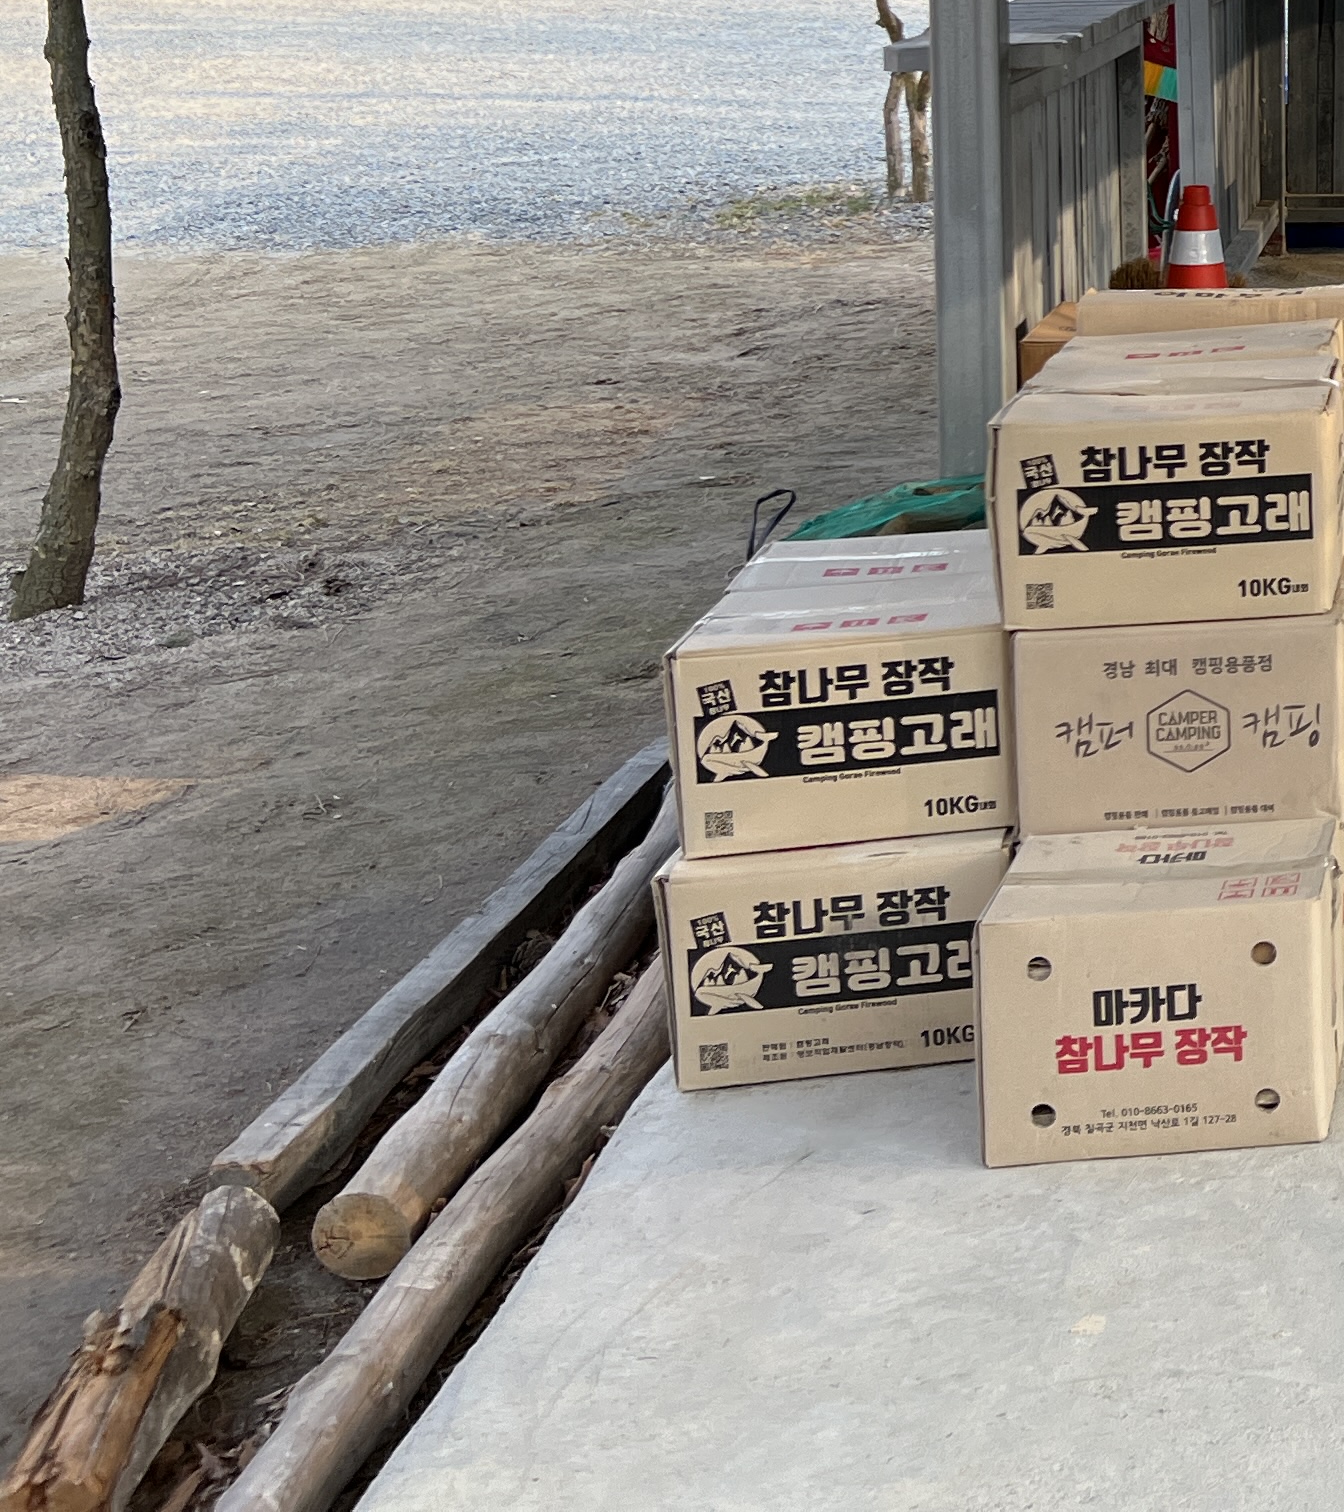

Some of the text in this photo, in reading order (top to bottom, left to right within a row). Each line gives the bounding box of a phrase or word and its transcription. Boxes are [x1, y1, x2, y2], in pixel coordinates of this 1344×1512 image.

[1080, 438, 1271, 483] 참나무 장작
[1115, 489, 1311, 542] 캠핑고래
[1103, 654, 1273, 680] 경남 최대 캠핑용품점
[759, 656, 955, 709] 참나무 장작
[701, 689, 731, 705] 국산
[1158, 710, 1218, 727] CAMPER
[1242, 703, 1321, 748] 캠핑
[796, 705, 998, 767] 캠핑고래
[1055, 712, 1134, 758] 캠퍼
[1155, 726, 1222, 743] CAMPING
[803, 776, 838, 786] Camping
[864, 768, 901, 779] Firewood
[1136, 850, 1208, 865] 마카다
[753, 885, 951, 940] 참나무 장작
[695, 921, 725, 938] 국산
[798, 1006, 833, 1015] Camping
[861, 998, 898, 1009] Firewood
[1093, 983, 1203, 1027] 마카다
[920, 1024, 974, 1048] 10KG
[1055, 1024, 1248, 1075] 참나무 장작
[1061, 1114, 1237, 1136] 경북 칠곡군 지천면 낙산로 1길 127-28
[1101, 1108, 1118, 1119] Tel.
